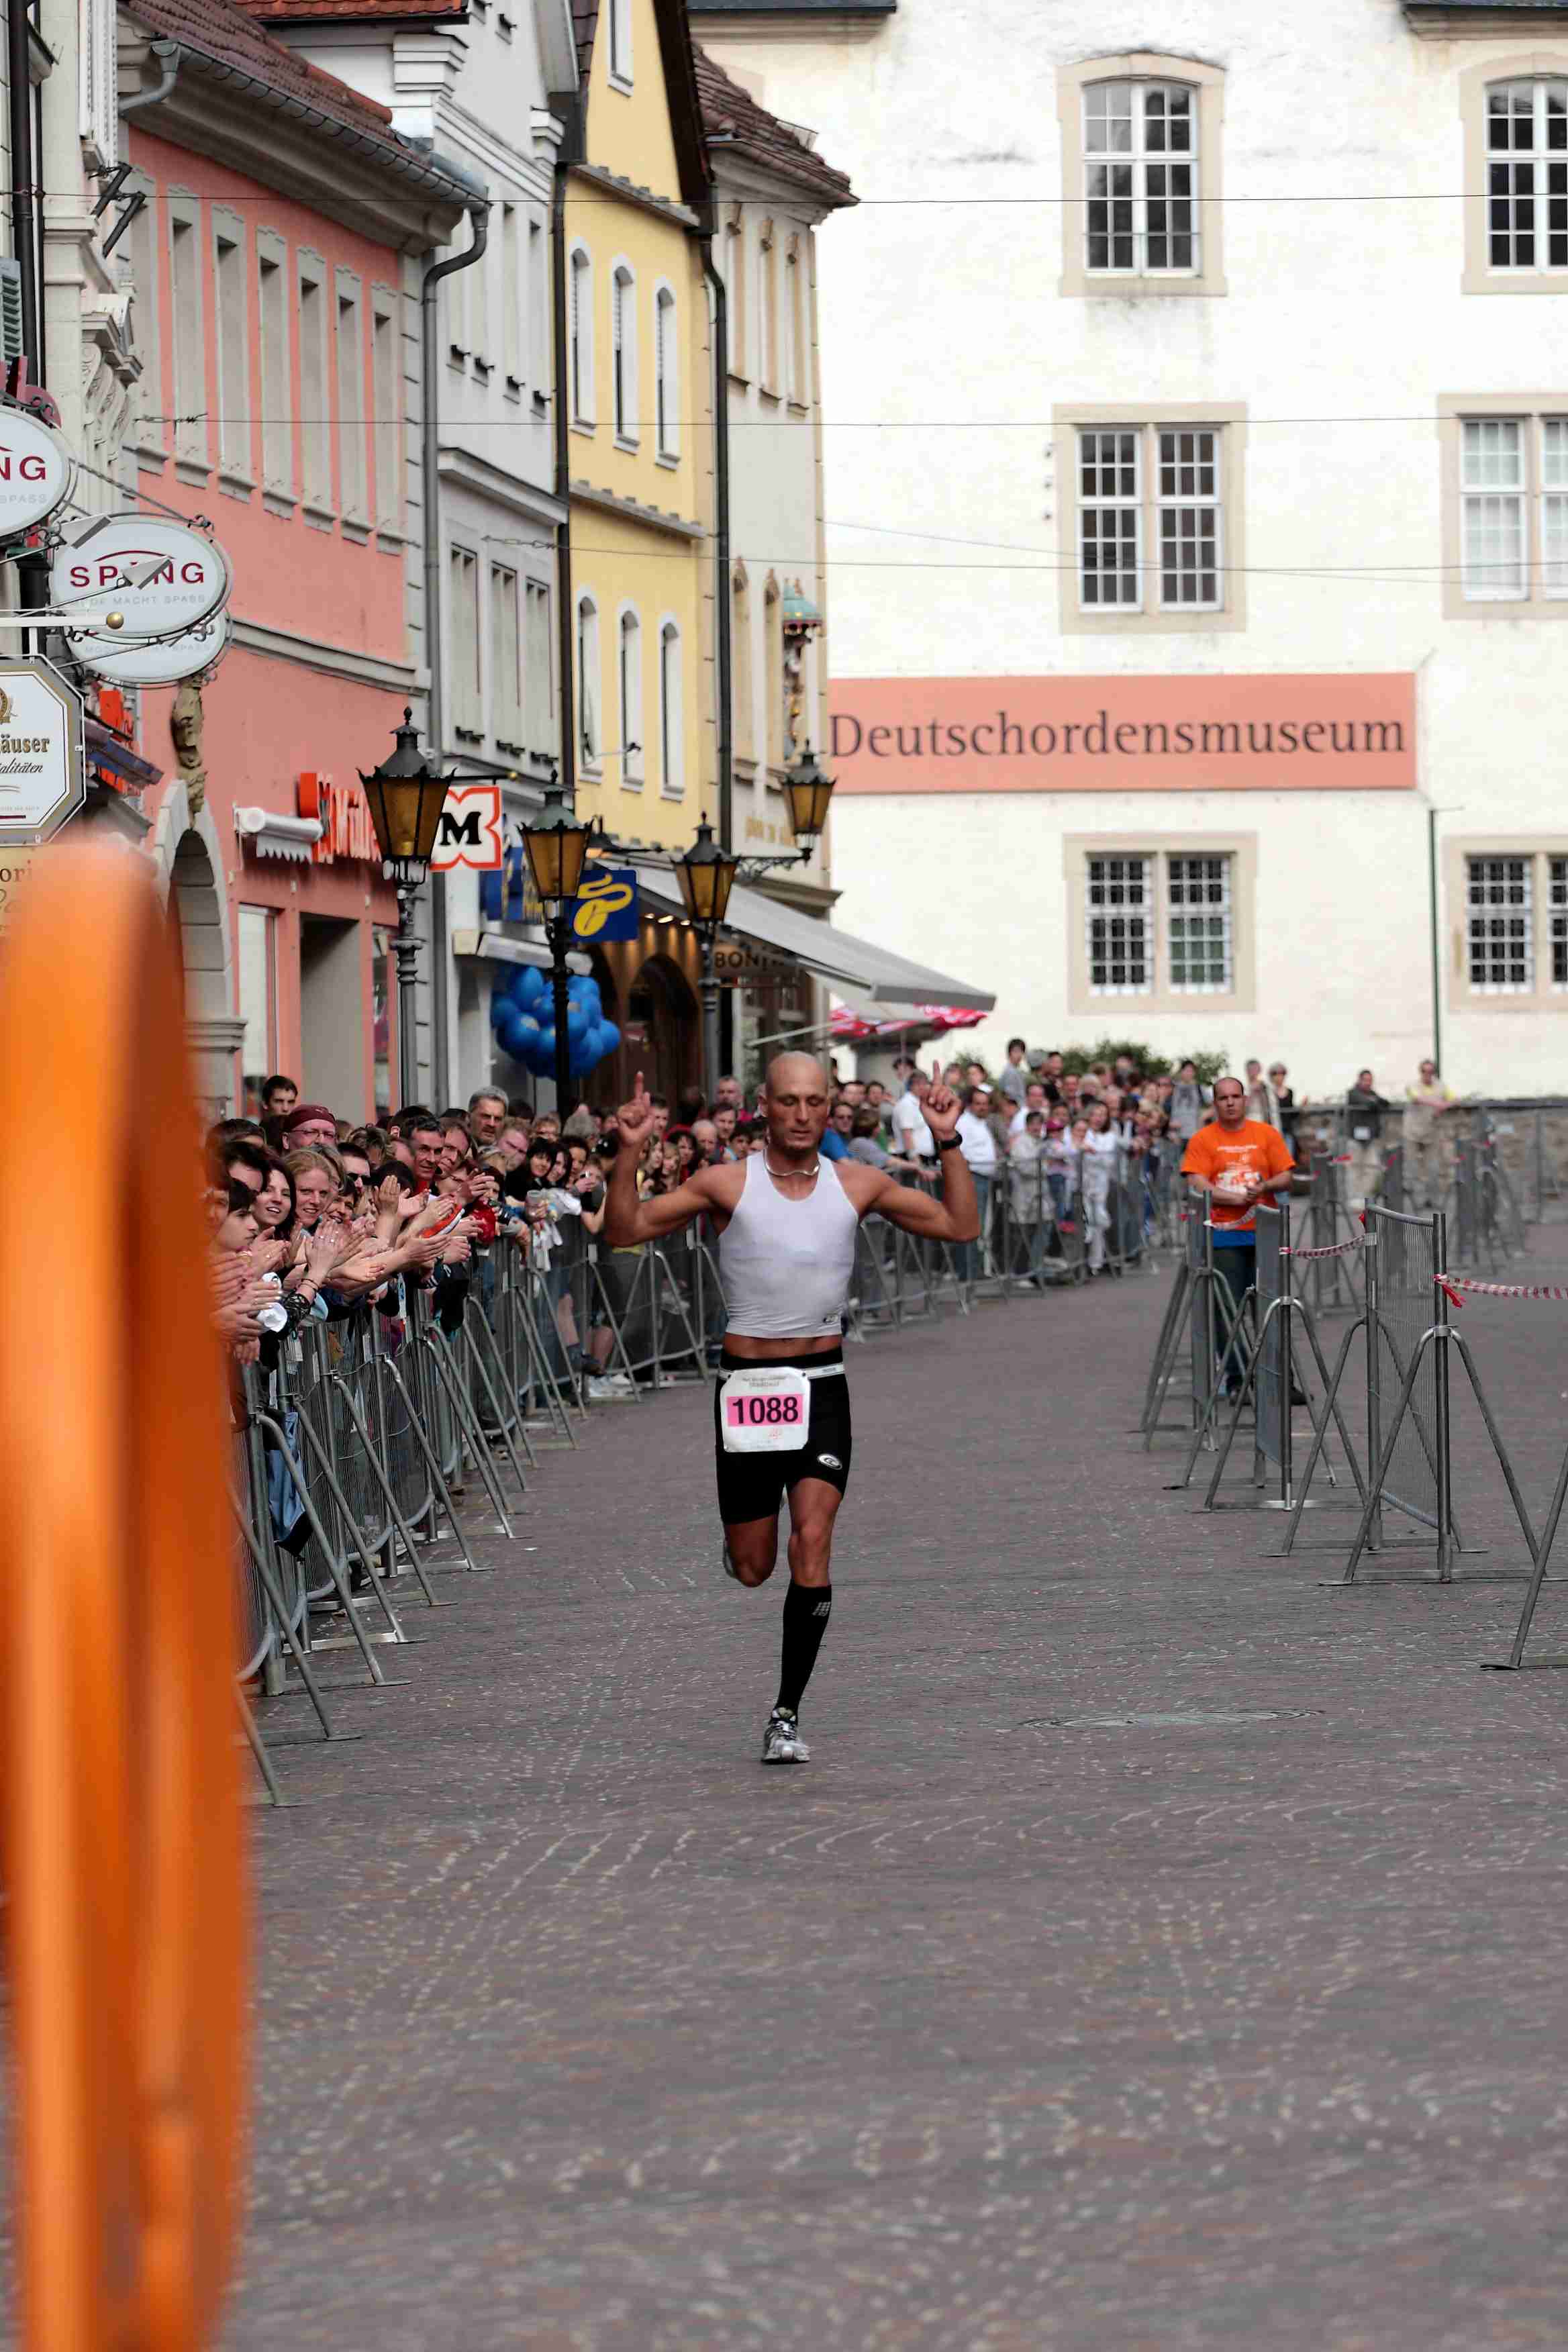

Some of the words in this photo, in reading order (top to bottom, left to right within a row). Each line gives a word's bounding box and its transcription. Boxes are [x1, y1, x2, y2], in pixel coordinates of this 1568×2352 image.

[70, 563, 205, 587] SPNG
[830, 712, 1405, 757] Deutschordensmuseum
[438, 812, 483, 846] M
[733, 1397, 799, 1424] 1088
